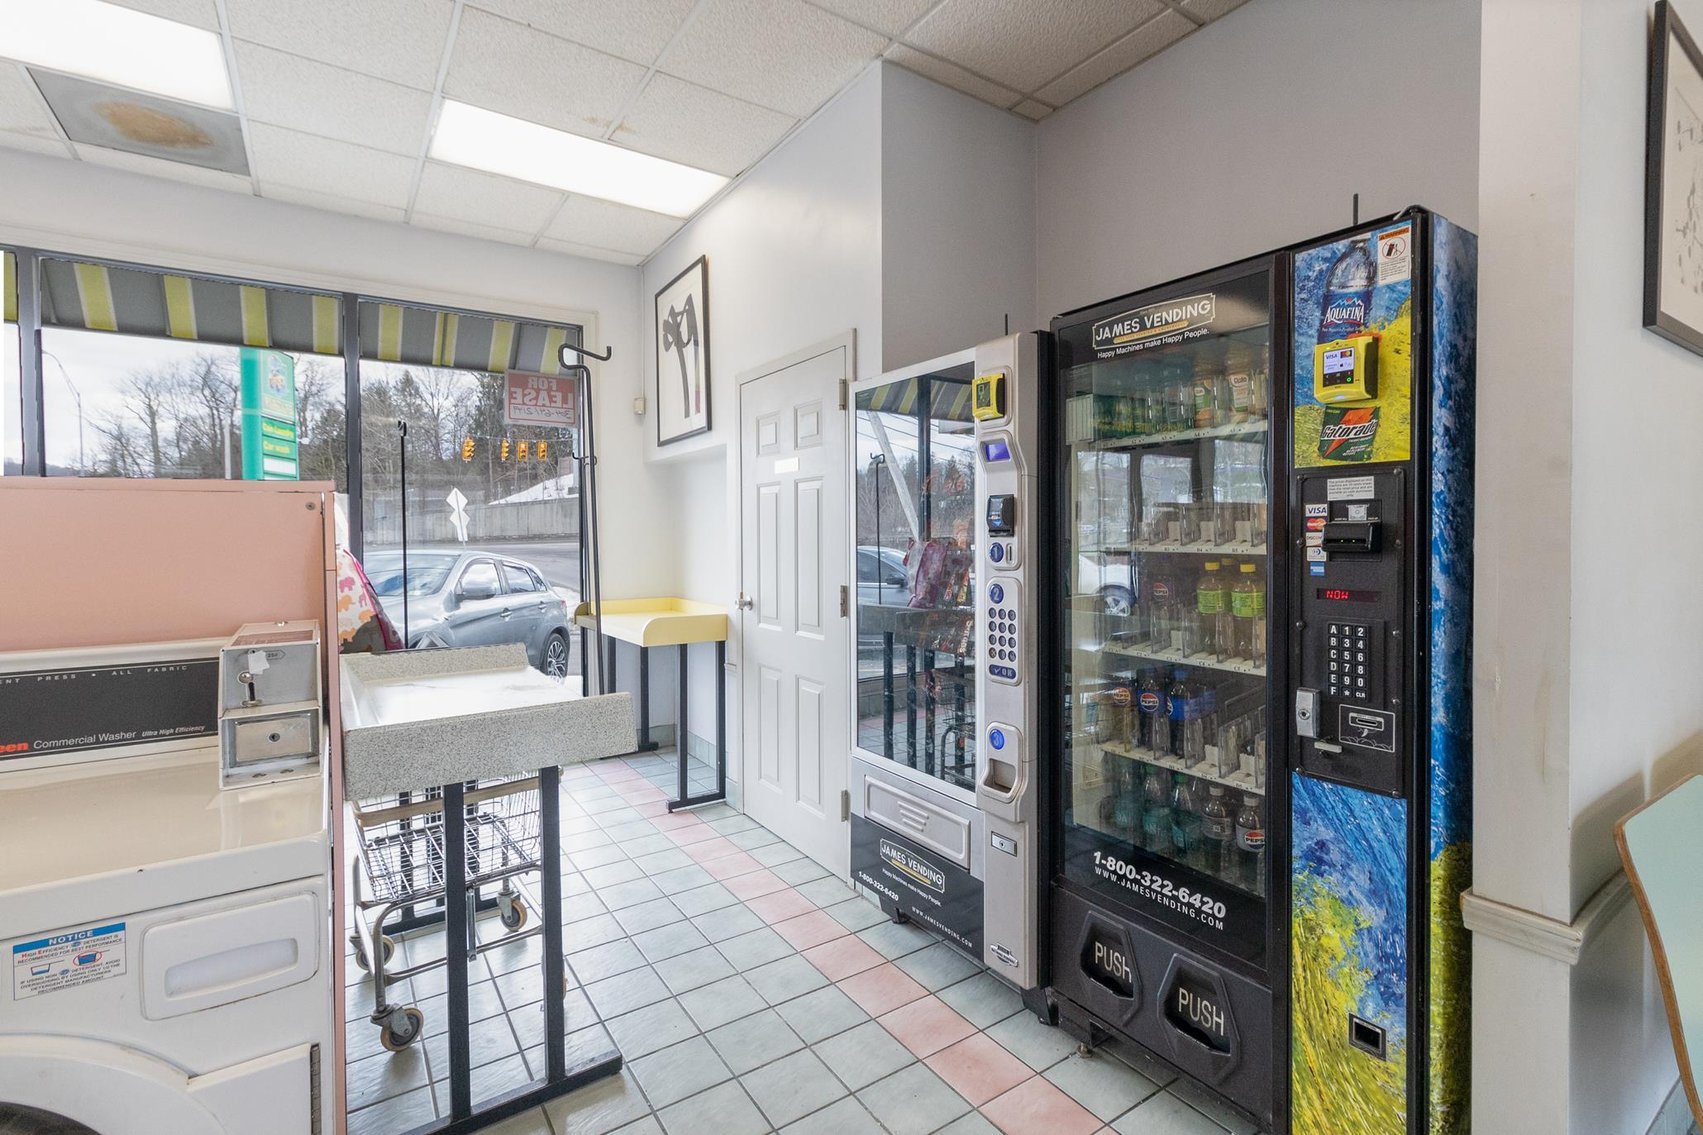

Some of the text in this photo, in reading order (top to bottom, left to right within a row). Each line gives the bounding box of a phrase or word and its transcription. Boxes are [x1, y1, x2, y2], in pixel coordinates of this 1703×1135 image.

[1096, 318, 1140, 341] JAMES
[1144, 300, 1211, 328] VENDING
[1323, 304, 1364, 325] AQUAFINA
[1098, 349, 1115, 359] Happy
[1116, 342, 1144, 354] Machines
[1144, 338, 1161, 348] make
[1162, 334, 1182, 344] Happy
[1184, 328, 1210, 339] People.
[1321, 420, 1378, 438] Gatorade
[1330, 625, 1364, 636] A 1 2
[1330, 638, 1364, 649] B 3 4
[1330, 650, 1364, 661] C 5 6
[1330, 662, 1364, 674] D 7 8
[38, 674, 76, 682] PRESS
[1330, 674, 1337, 683] E
[1344, 676, 1349, 684] 9
[1331, 687, 1336, 695] F
[33, 734, 96, 750] Commercial
[98, 730, 136, 743] Washer
[175, 726, 206, 734] Efficiency
[881, 844, 906, 864] JAMES
[908, 858, 942, 884] VENDING
[858, 871, 899, 901] 1-800-322-6420
[1093, 850, 1226, 918] 1-800-322-6420
[1094, 866, 1224, 930] WWW.JAMESVENDING.COM
[911, 906, 972, 948] WWW.JAMESVENDING.COM
[49, 930, 94, 946] NOTICE
[18, 952, 59, 964] RECOMMENDED
[1178, 988, 1224, 1036] PUSH
